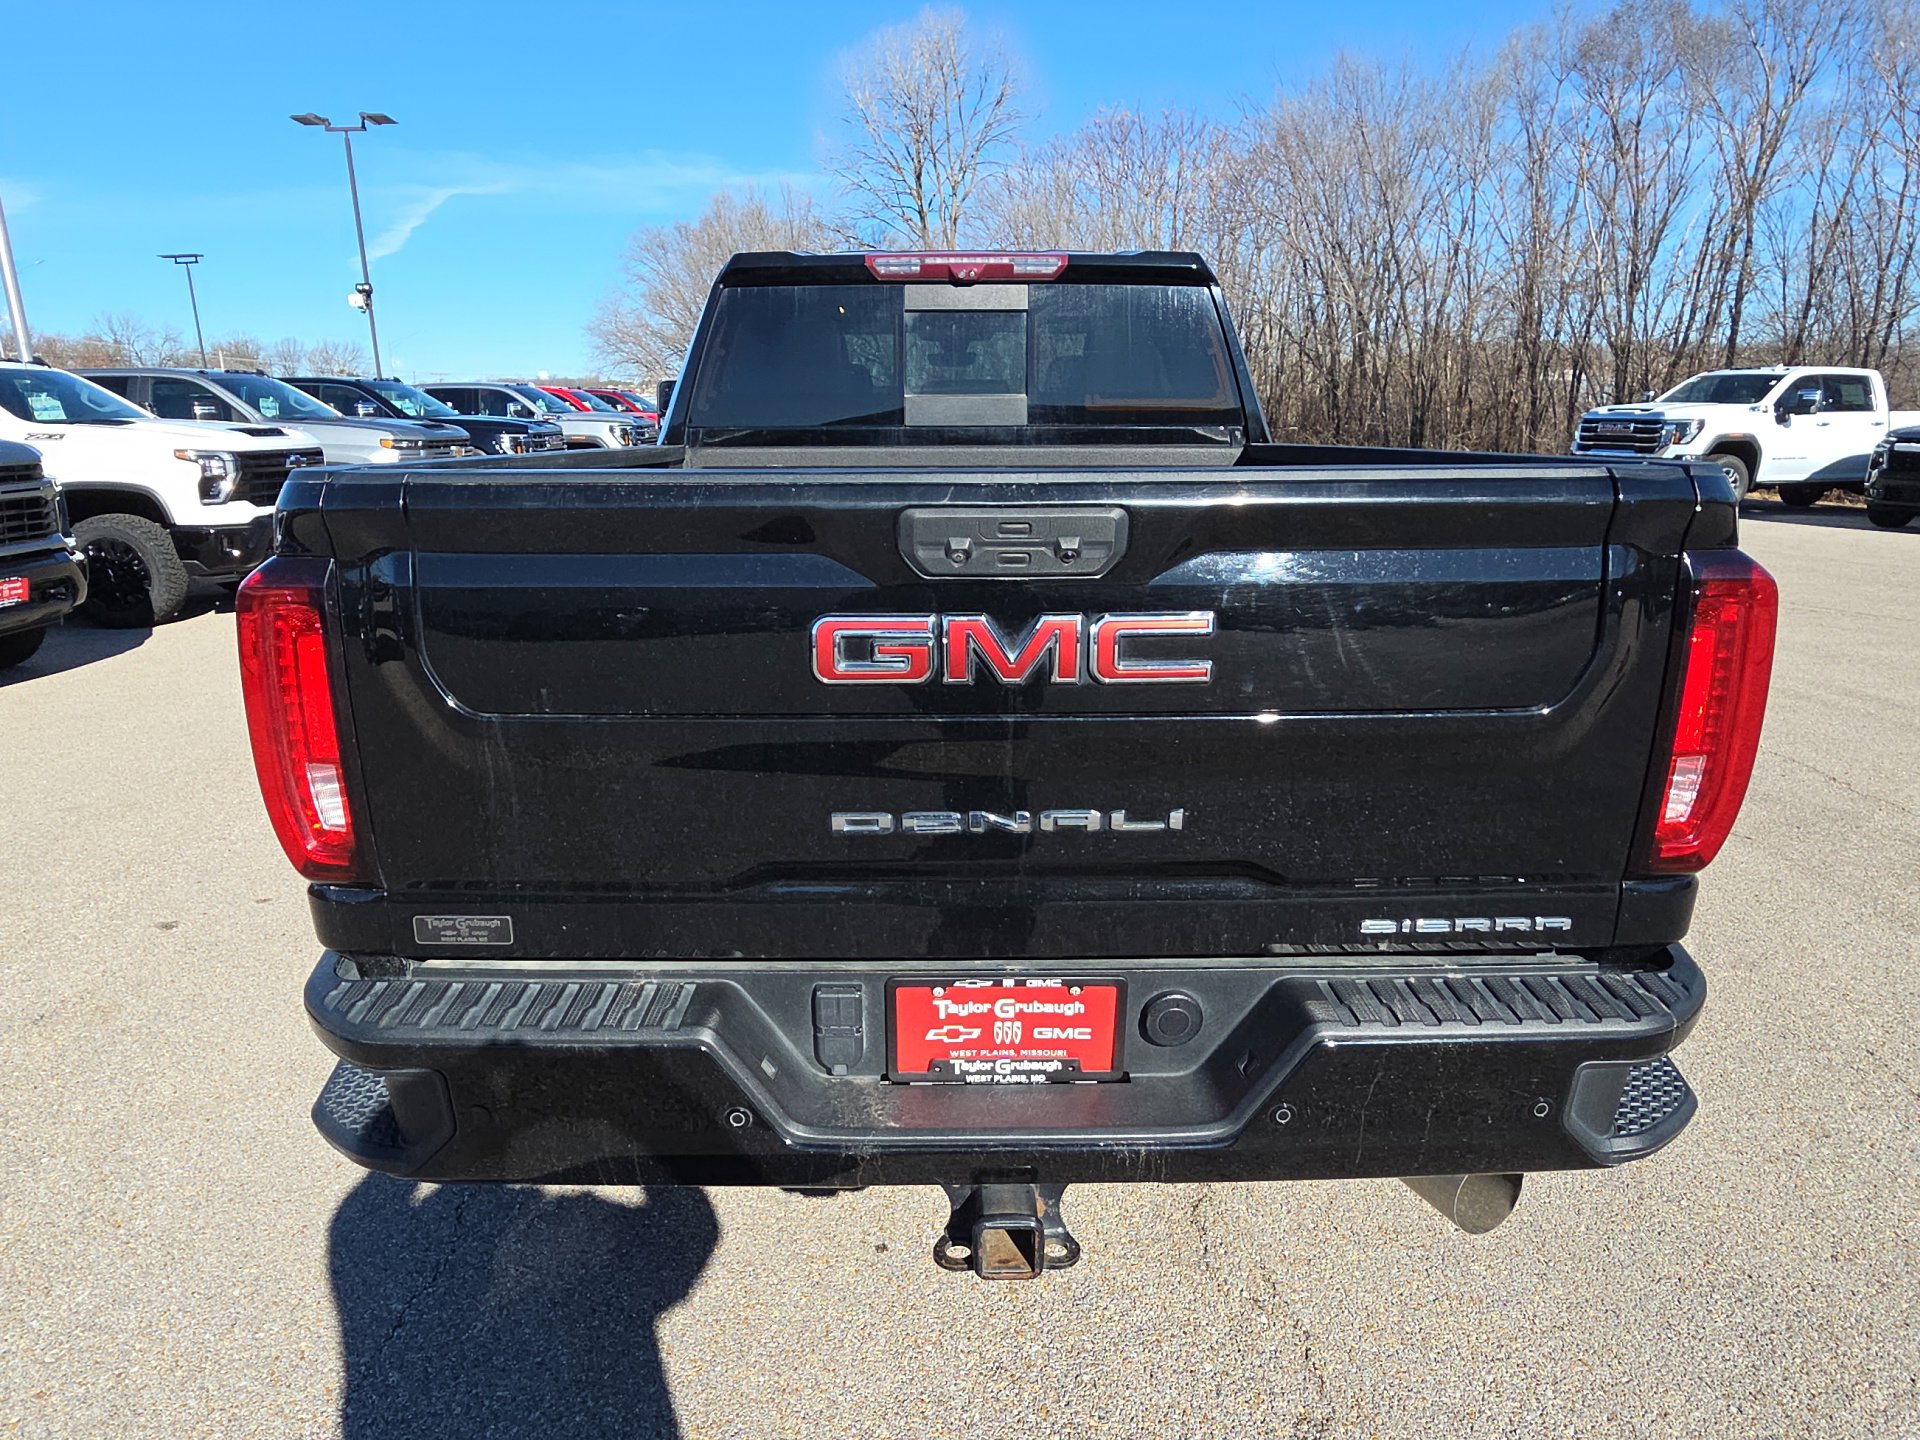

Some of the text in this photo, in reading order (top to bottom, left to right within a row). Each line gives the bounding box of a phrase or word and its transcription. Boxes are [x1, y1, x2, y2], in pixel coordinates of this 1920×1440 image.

[810, 611, 1215, 686] GMC
[830, 808, 1185, 836] DENALI
[424, 918, 501, 929] Taylor Grubaugh
[1360, 916, 1572, 934] SIERRA
[1025, 979, 1063, 988] GMC
[932, 998, 1085, 1020] Taylor Grubaugh
[1033, 1027, 1092, 1040] GMC
[949, 1049, 1067, 1057] WEST PLAINS, MISSOURI
[949, 1058, 1063, 1075] Taylor Grubaugh
[965, 1074, 992, 1083] WEST
[1030, 1074, 1047, 1083] MO
